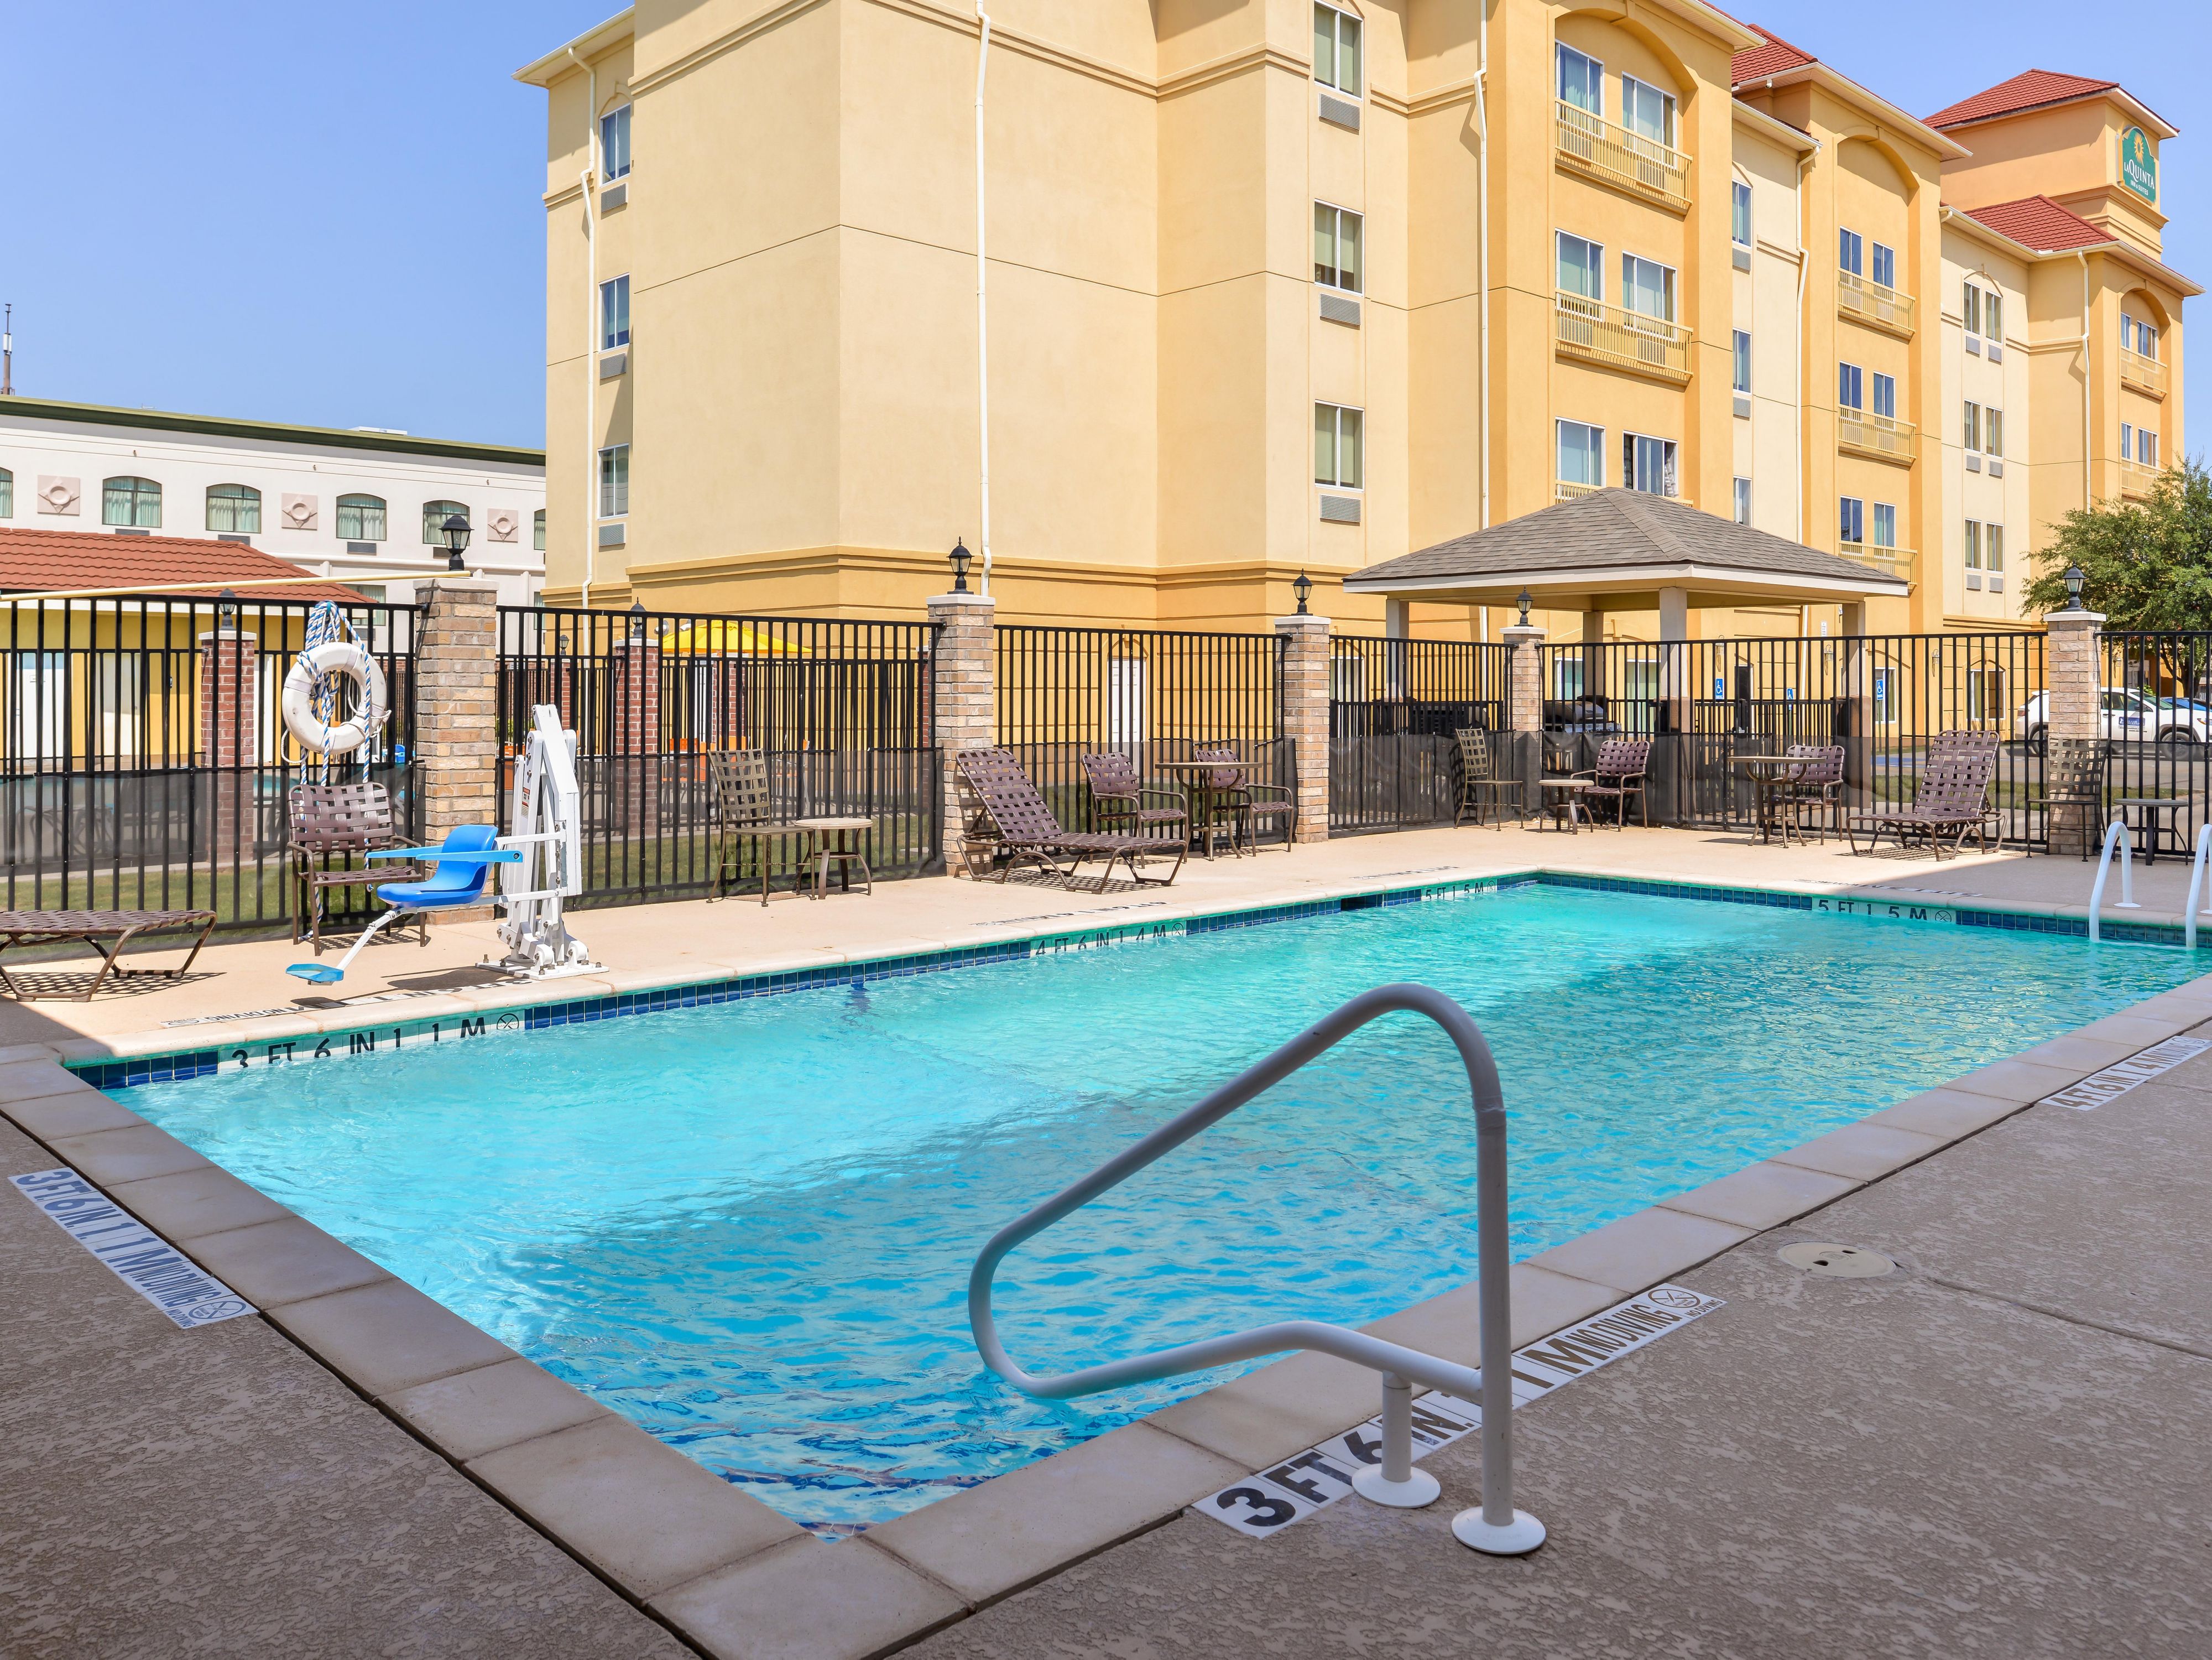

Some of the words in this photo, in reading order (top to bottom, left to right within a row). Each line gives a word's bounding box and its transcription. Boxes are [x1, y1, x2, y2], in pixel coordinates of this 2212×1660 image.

[2124, 162, 2129, 173] LA
[2129, 159, 2154, 189] QUINTA
[2138, 184, 2148, 195] SUITES
[1426, 889, 1432, 899] 5
[1437, 887, 1446, 901] FT
[1464, 883, 1469, 894] 5
[1475, 882, 1483, 894] M
[1818, 899, 1829, 911] 5
[1838, 901, 1854, 913] FT
[1888, 906, 1900, 918] 5
[1910, 908, 1928, 920] M
[1036, 940, 1046, 956] 4
[1055, 938, 1069, 954] FT
[1078, 935, 1087, 950] 6
[1096, 932, 1109, 948] IN
[1136, 927, 1144, 940] 4
[1153, 924, 1166, 938] M
[232, 1051, 249, 1069] 3
[268, 1041, 296, 1064] FT
[315, 1037, 331, 1059] 6
[350, 1032, 374, 1054] IN
[432, 1023, 439, 1042] 1
[460, 1017, 486, 1038] M
[2049, 1097, 2095, 1107] 4
[2083, 1081, 2126, 1092] 6
[2133, 1054, 2182, 1065] M
[17, 1171, 74, 1185] 3
[44, 1198, 106, 1211] 6
[107, 1247, 183, 1274] M
[129, 1264, 191, 1282] NO
[141, 1273, 222, 1308] DIVING
[1694, 1299, 1723, 1313] DIVING
[171, 1314, 196, 1326] DIVING
[1588, 1304, 1683, 1342] DIVING
[1565, 1329, 1628, 1353] NO
[1520, 1338, 1610, 1375] M
[1217, 1487, 1296, 1527] 3
